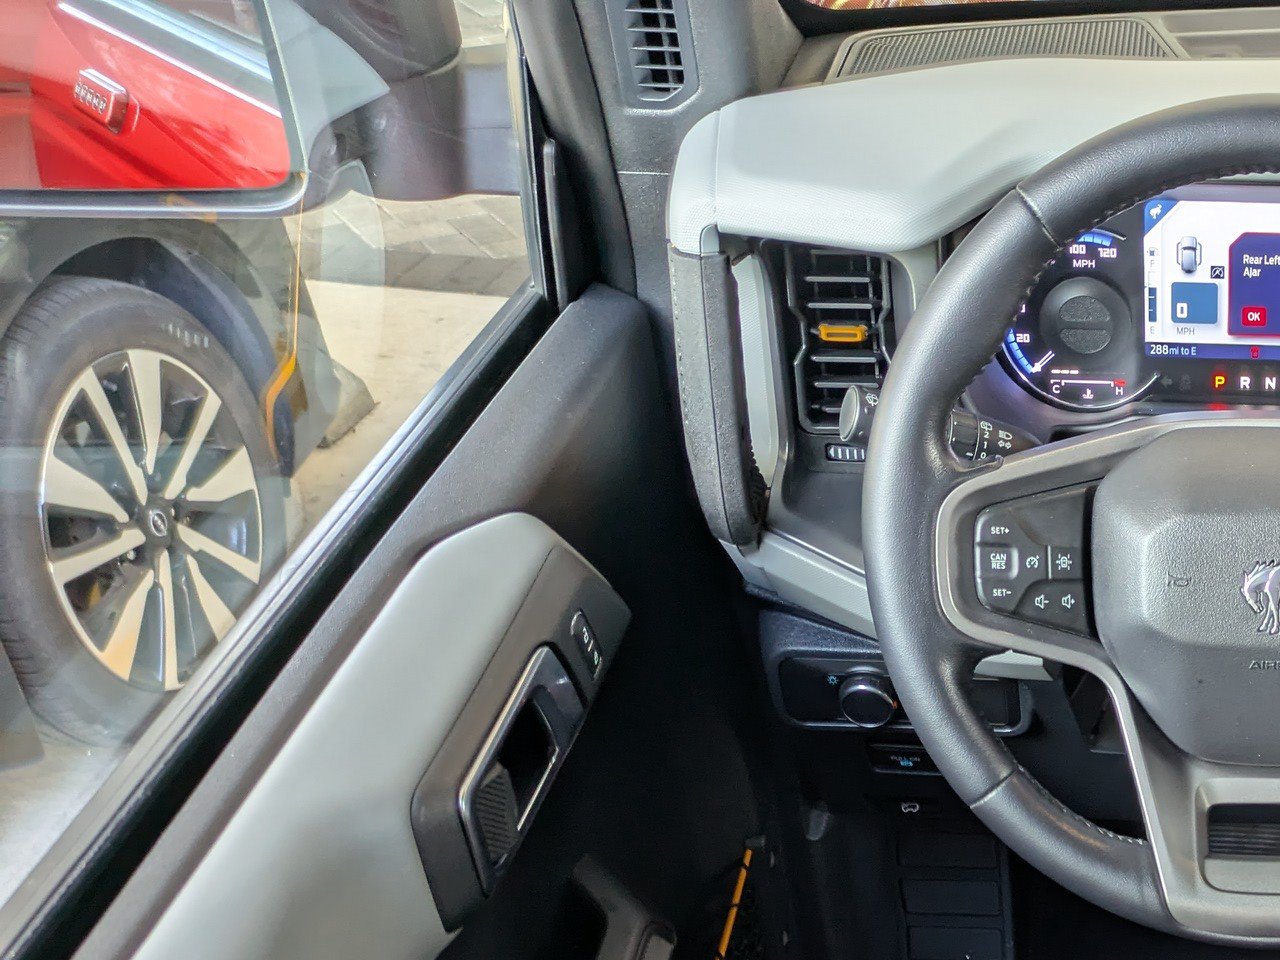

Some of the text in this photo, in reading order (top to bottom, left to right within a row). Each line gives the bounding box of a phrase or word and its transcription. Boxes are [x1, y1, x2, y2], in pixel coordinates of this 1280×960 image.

[1069, 244, 1087, 255] 100
[1097, 247, 1118, 259] 120
[1072, 258, 1096, 269] MPH
[1242, 254, 1263, 265] Rear
[1242, 266, 1262, 279] Ajar
[1176, 302, 1189, 319] 0
[1247, 311, 1261, 322] OK
[1176, 327, 1196, 336] MPH
[1015, 333, 1031, 343] 20
[1180, 346, 1190, 356] to
[1191, 347, 1197, 356] E
[1214, 375, 1226, 389] P
[1239, 376, 1251, 390] R
[1264, 376, 1277, 391] N
[1052, 384, 1061, 394] C
[1115, 386, 1124, 396] H
[983, 431, 990, 439] 2
[983, 441, 988, 449] 1
[980, 451, 987, 459] 0
[990, 526, 1010, 535] SET+
[990, 553, 1007, 561] CAN
[991, 562, 1006, 570] RES
[992, 588, 1012, 597] SET-
